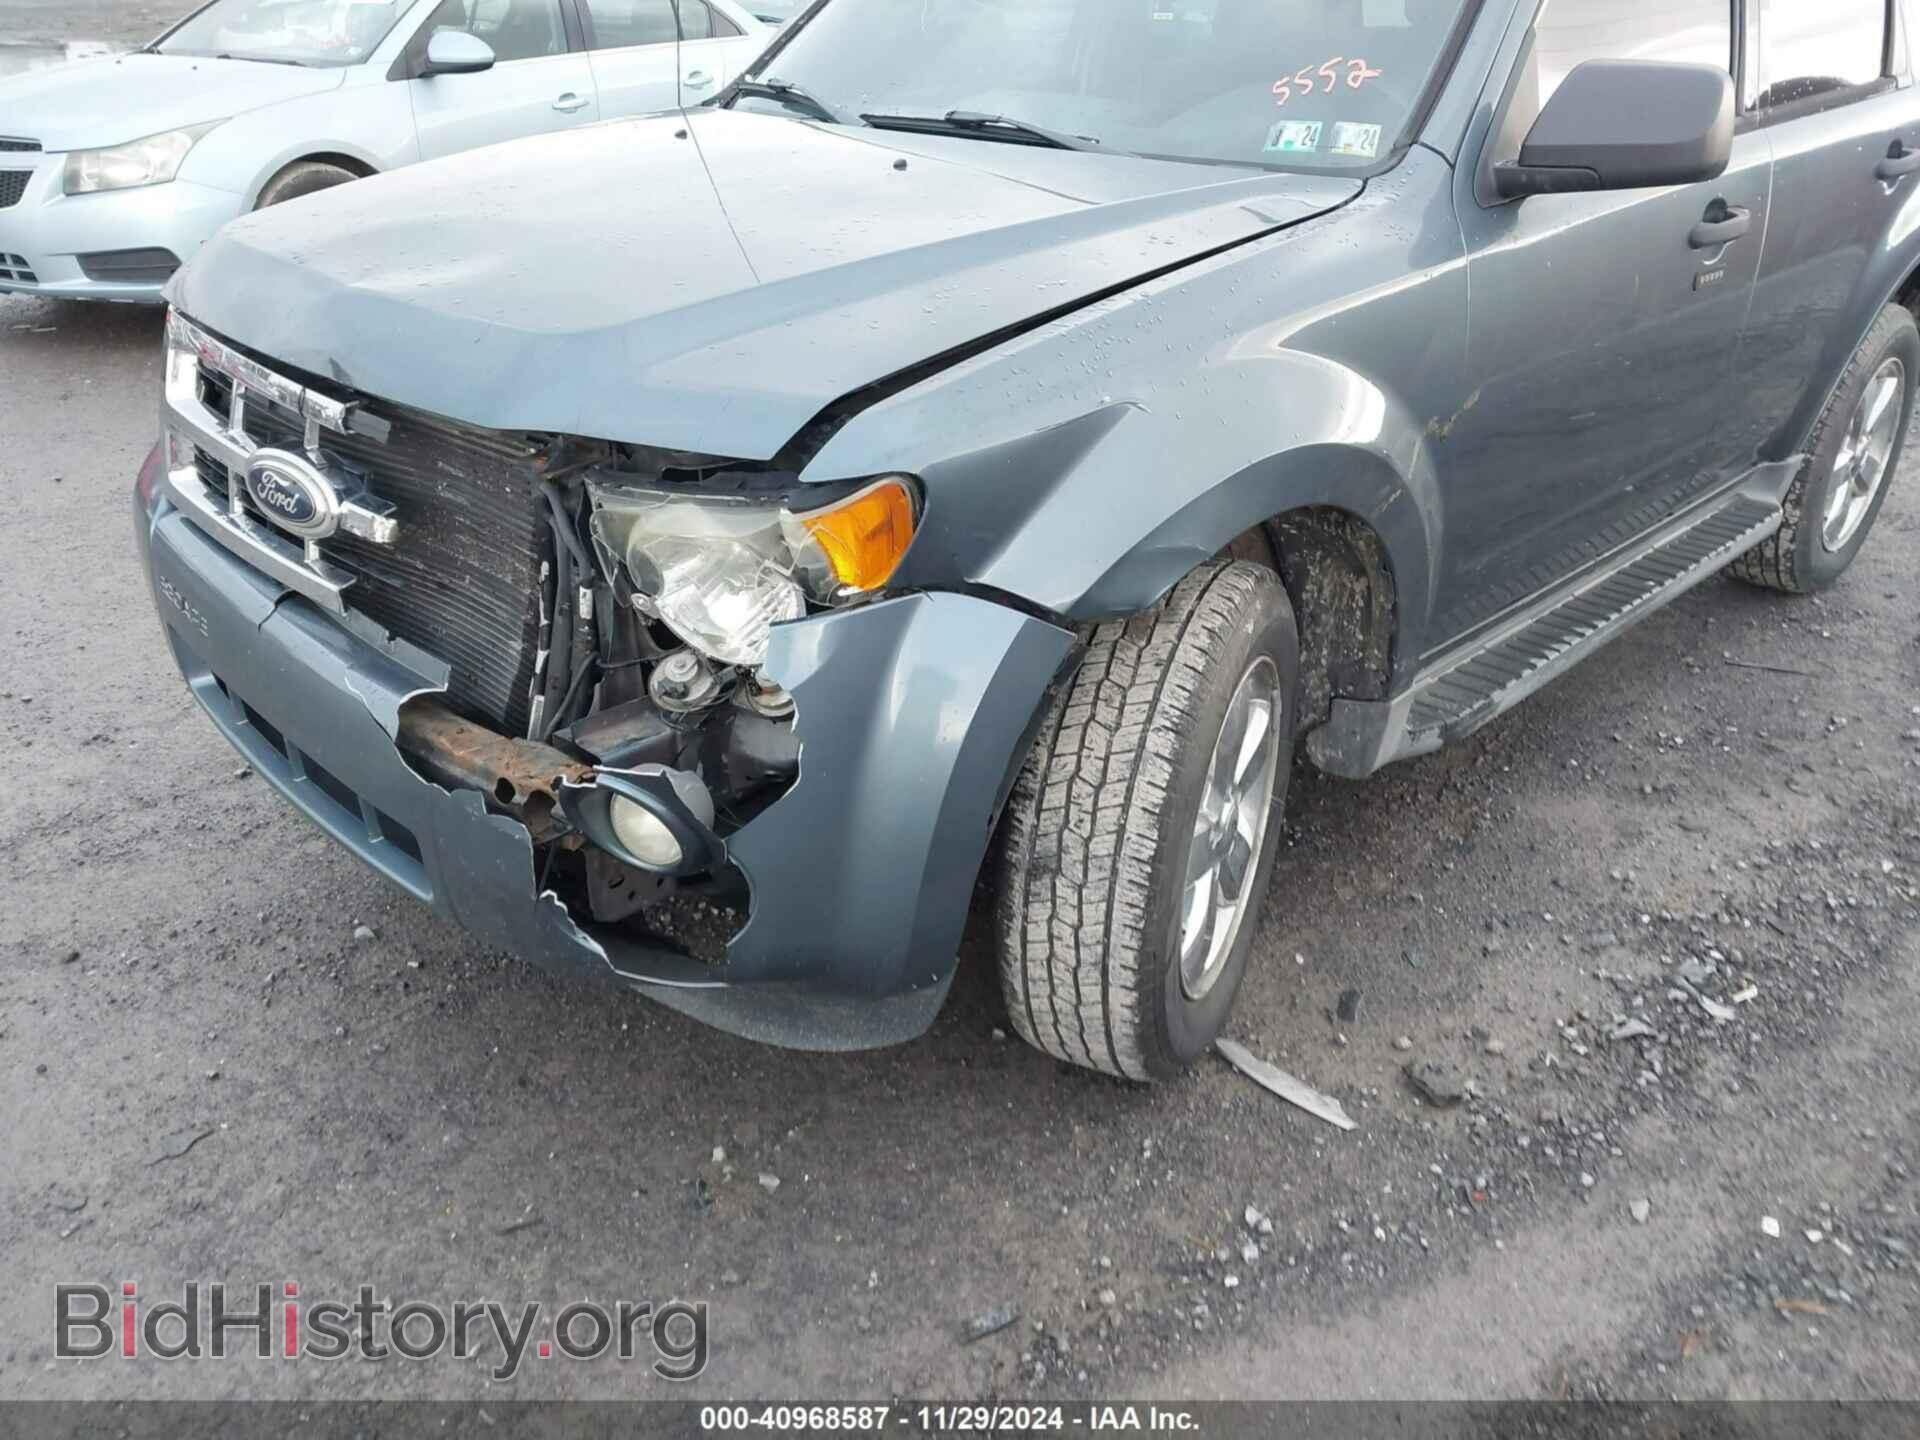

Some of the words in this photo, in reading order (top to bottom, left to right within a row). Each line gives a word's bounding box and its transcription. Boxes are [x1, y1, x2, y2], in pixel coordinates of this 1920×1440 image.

[1272, 56, 1383, 105] 5552
[1301, 125, 1319, 147] 24
[1360, 128, 1377, 150] 24
[256, 470, 300, 515] Ford
